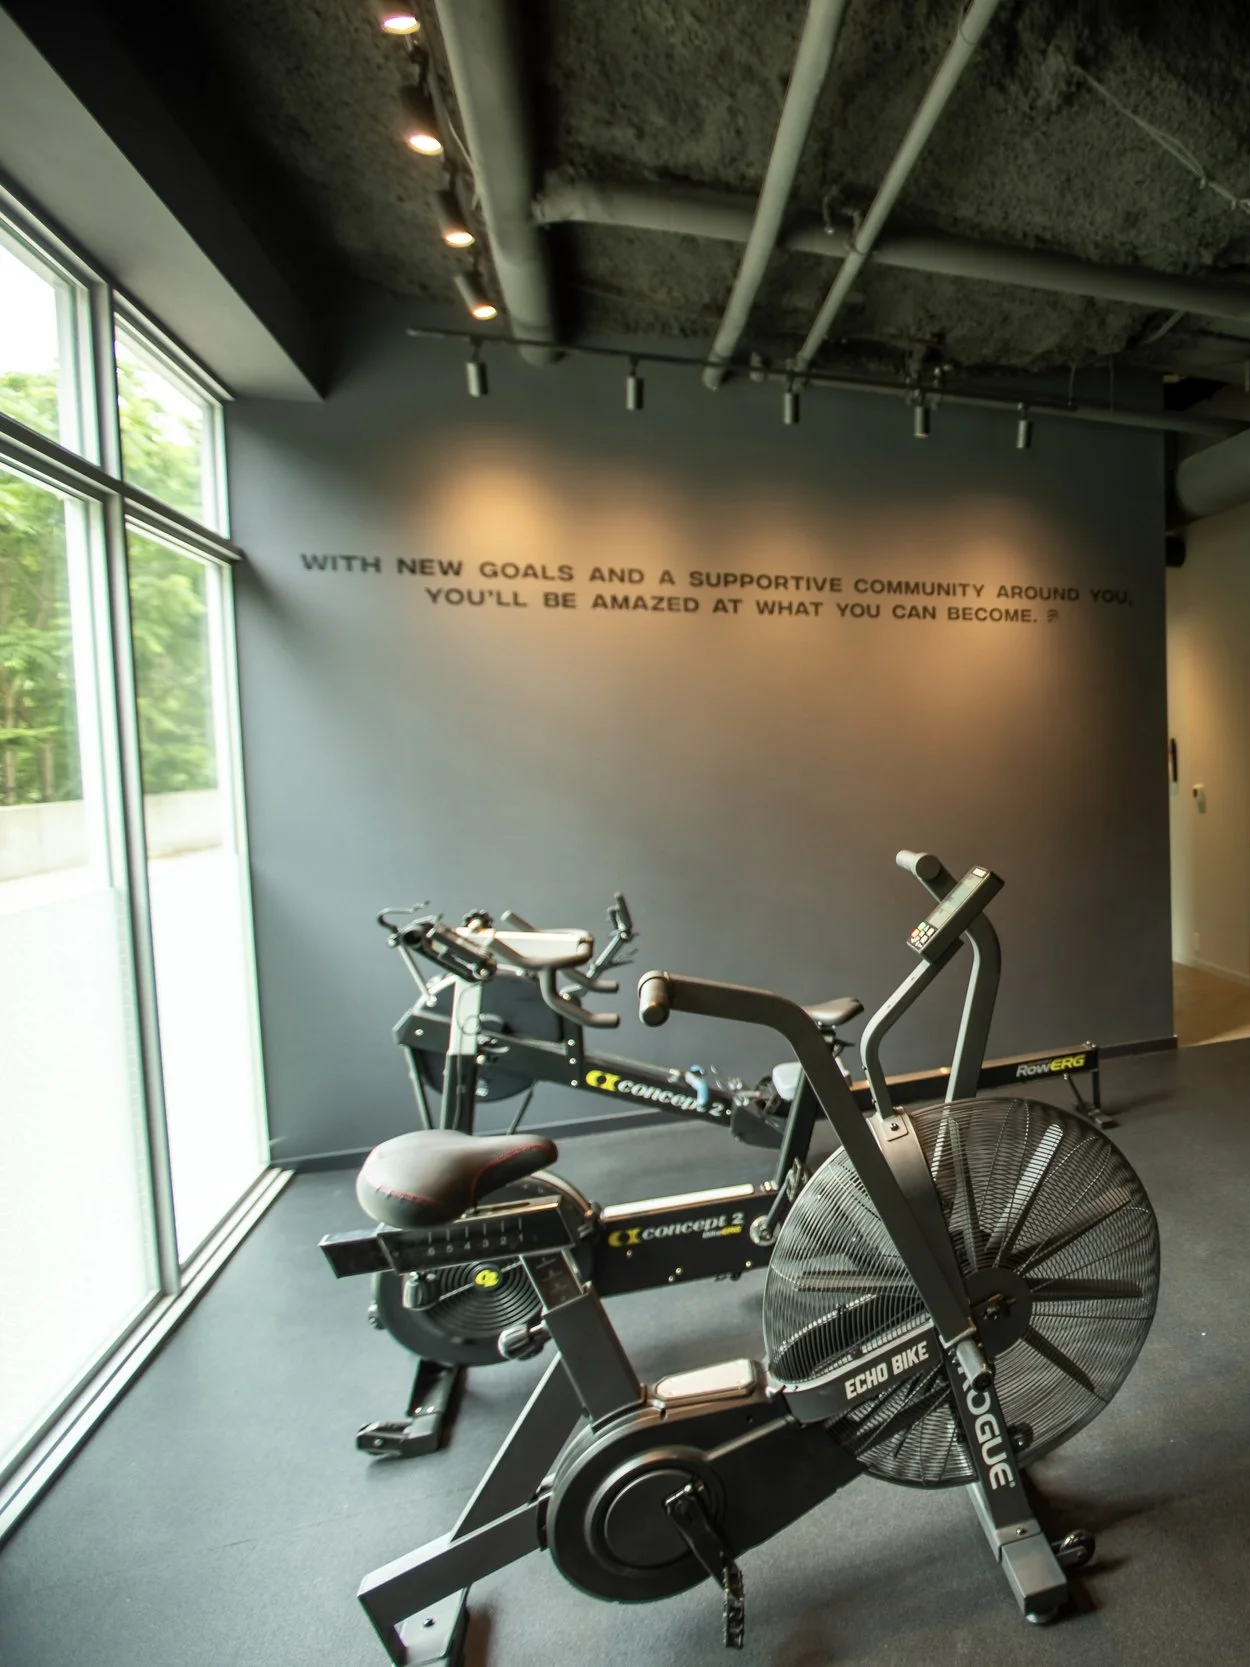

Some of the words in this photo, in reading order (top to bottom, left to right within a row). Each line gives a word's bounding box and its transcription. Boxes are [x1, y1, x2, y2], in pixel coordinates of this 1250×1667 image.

[300, 553, 382, 574] WITH
[397, 557, 463, 577] NEW
[479, 560, 575, 583] GOALS
[588, 566, 645, 585] AND
[657, 569, 677, 587] A
[688, 570, 843, 593] SUPPORTIVE
[853, 577, 985, 599] COMMUNITY
[996, 584, 1080, 602] AROUND
[1089, 588, 1134, 607] YOU,
[424, 587, 528, 608] YOU'LL
[543, 591, 577, 609] BE
[591, 594, 700, 614] AMAZED
[712, 597, 743, 614] AT
[756, 599, 824, 617] WHAT
[837, 601, 881, 619] YOU
[891, 604, 937, 621] CAN
[946, 606, 1039, 624] BECOME.
[1016, 1054, 1086, 1077] RowERG
[708, 1102, 725, 1117] 2
[641, 1214, 728, 1240] concept
[731, 1211, 745, 1225] 2
[844, 1362, 889, 1400] ECHO
[891, 1340, 929, 1376] BIKE
